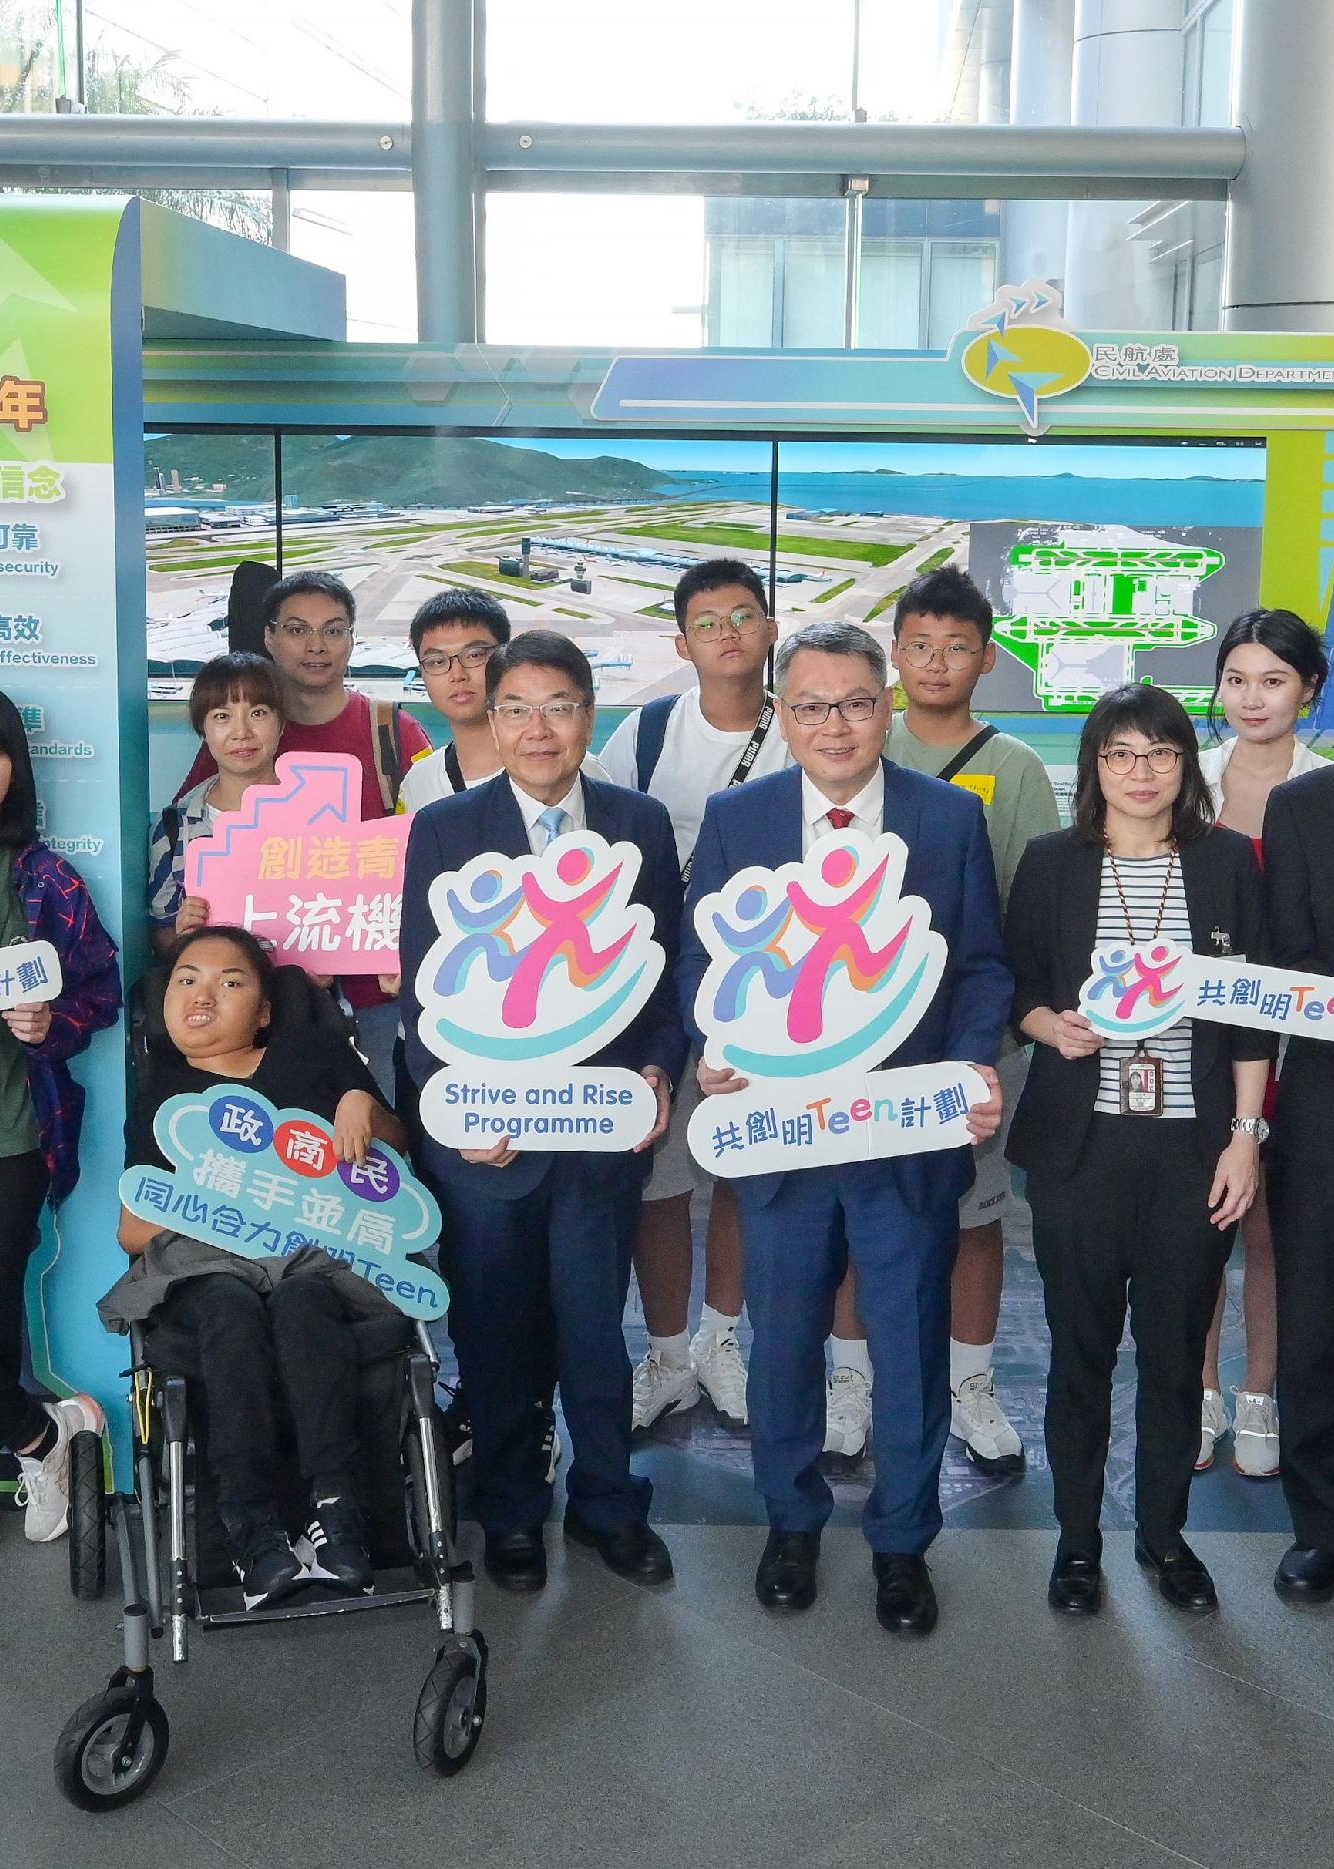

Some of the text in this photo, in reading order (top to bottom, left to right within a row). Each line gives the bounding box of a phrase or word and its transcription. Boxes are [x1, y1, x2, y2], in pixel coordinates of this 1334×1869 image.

[1094, 346, 1176, 362] 民航處
[1094, 365, 1142, 378] CIVIL
[1147, 367, 1232, 380] AVIATION
[741, 740, 760, 769] PUMA
[258, 834, 400, 881] 創造青
[445, 1082, 633, 1106] Strive and Rise
[464, 1113, 614, 1140] Programme
[711, 1082, 968, 1159] 共創明Teen計劃
[192, 1148, 397, 1255] 攜手並肩
